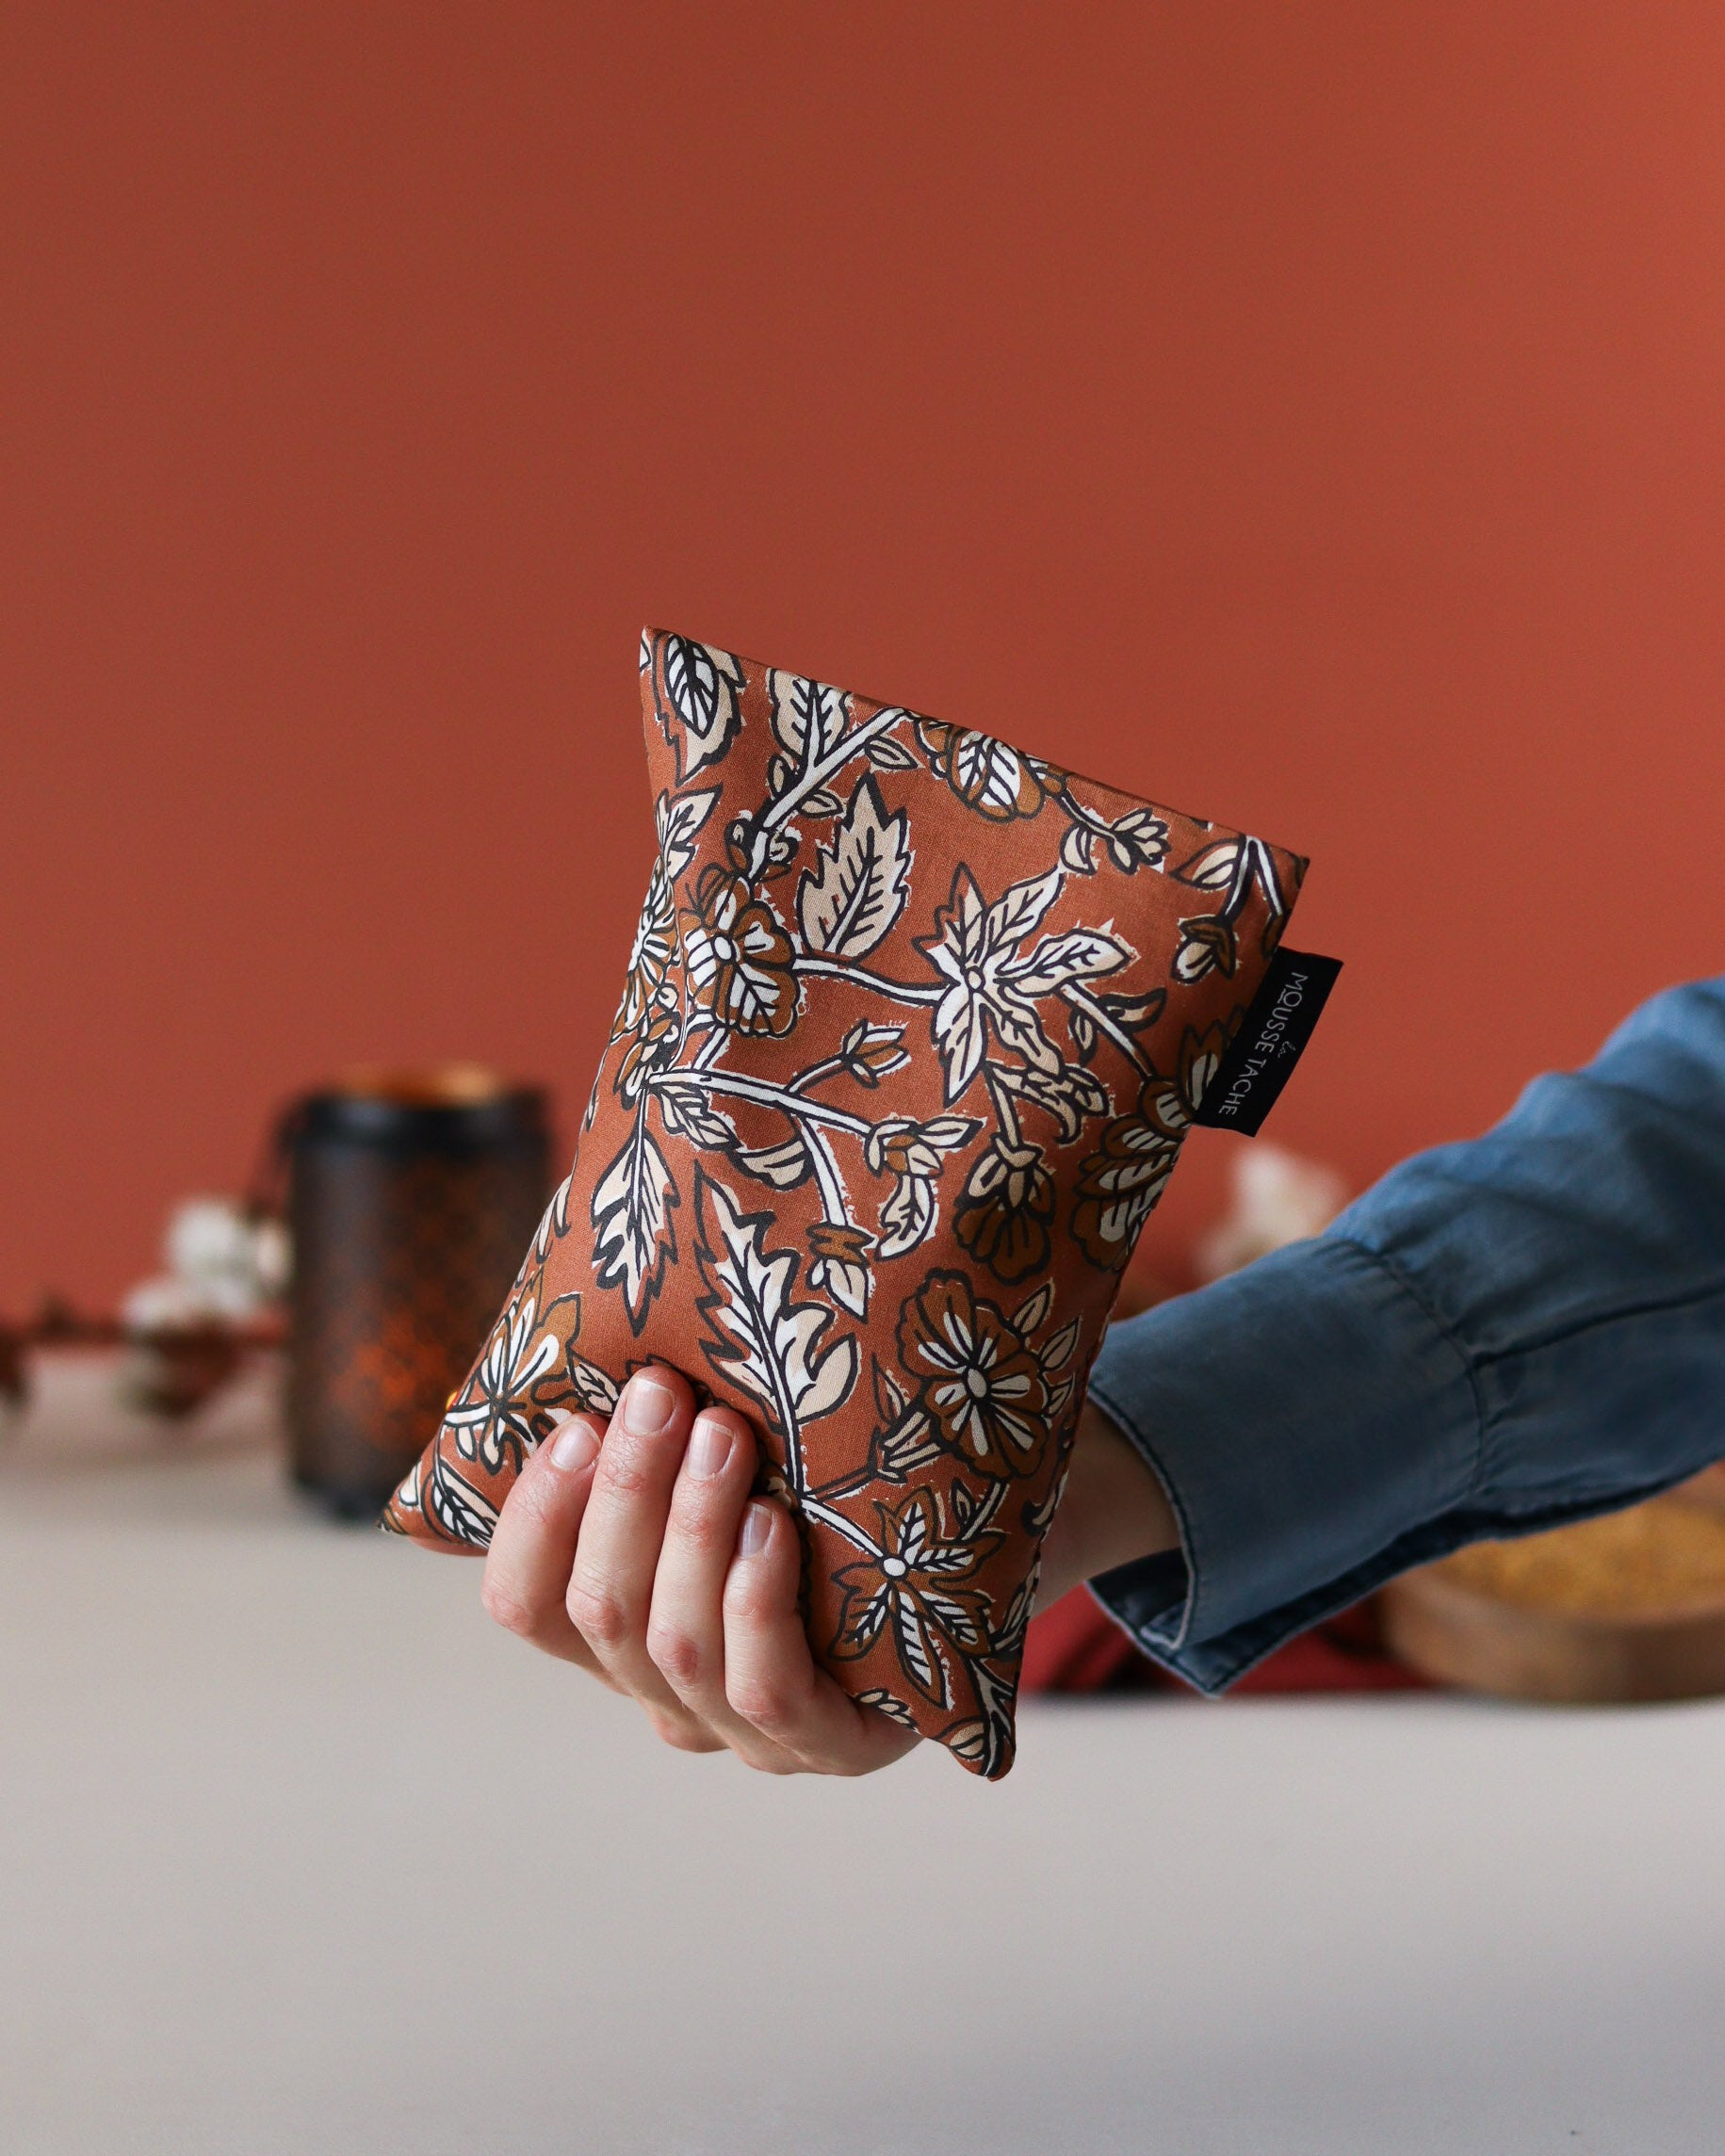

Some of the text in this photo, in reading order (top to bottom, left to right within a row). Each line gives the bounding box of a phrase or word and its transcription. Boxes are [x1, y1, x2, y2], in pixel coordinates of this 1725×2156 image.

[1218, 972, 1309, 1115] MOUSSE TACHE
[1277, 1040, 1296, 1059] la
